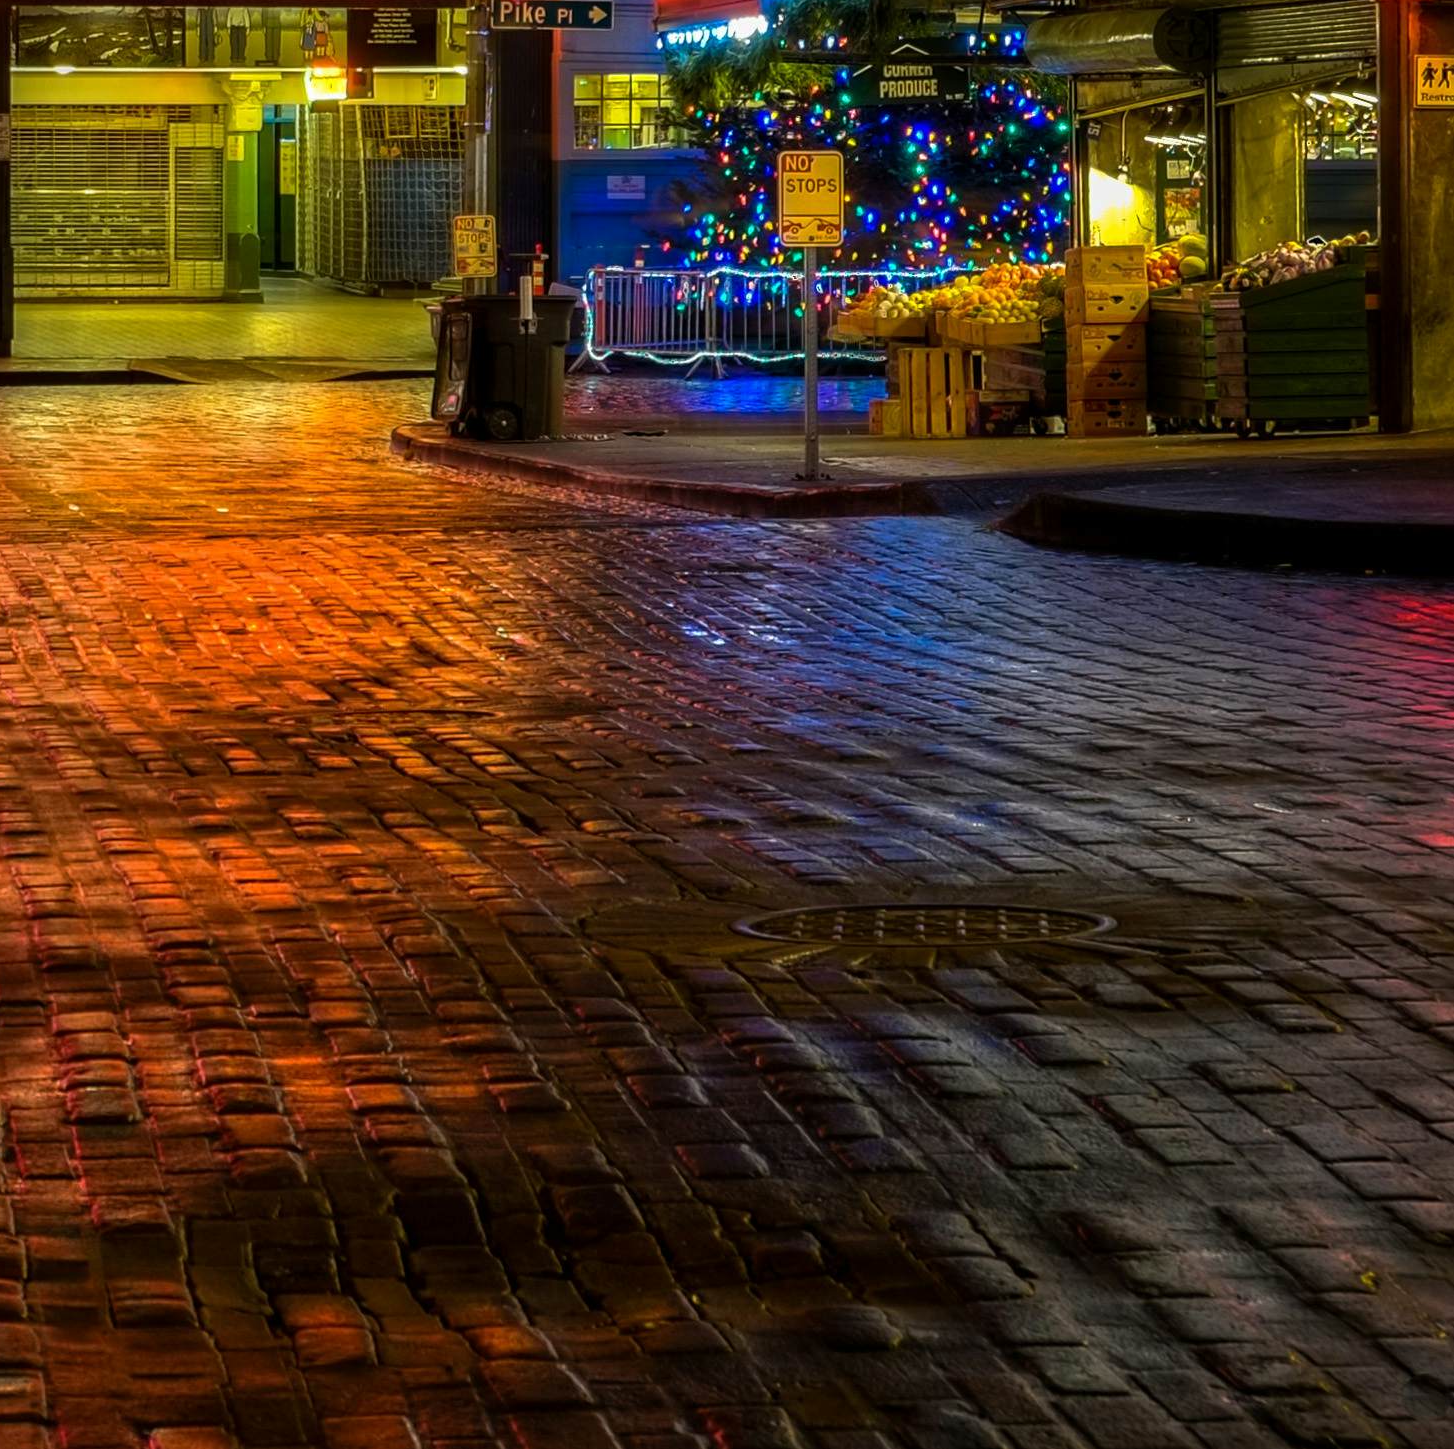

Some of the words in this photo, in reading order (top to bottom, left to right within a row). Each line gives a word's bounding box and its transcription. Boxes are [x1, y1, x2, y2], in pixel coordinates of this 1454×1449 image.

[500, 1, 546, 24] Pike
[557, 9, 573, 24] Pl
[879, 79, 938, 98] PRODUCE
[785, 155, 809, 171] NO
[786, 178, 838, 193] STOPS
[456, 219, 473, 230] NO
[458, 233, 492, 243] STOPS
